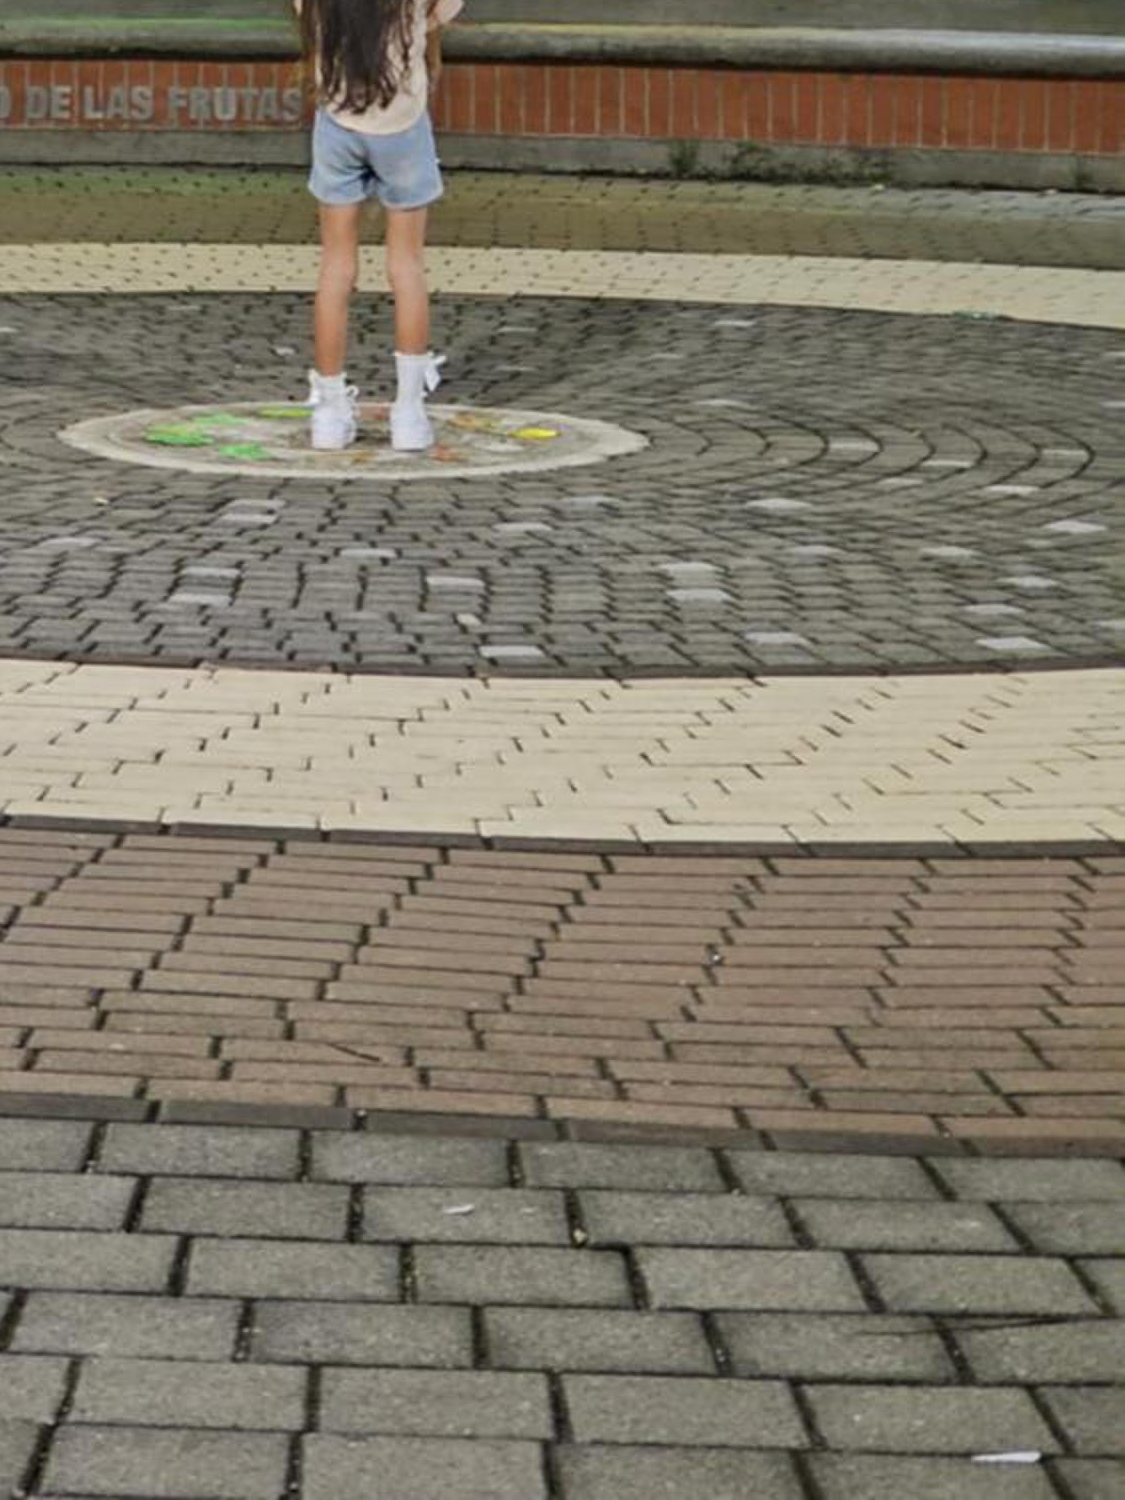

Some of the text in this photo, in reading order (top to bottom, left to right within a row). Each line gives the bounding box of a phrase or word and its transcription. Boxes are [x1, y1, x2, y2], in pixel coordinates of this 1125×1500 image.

[25, 86, 71, 119] DE
[83, 86, 153, 119] LAS
[168, 86, 303, 122] FRUTAS
